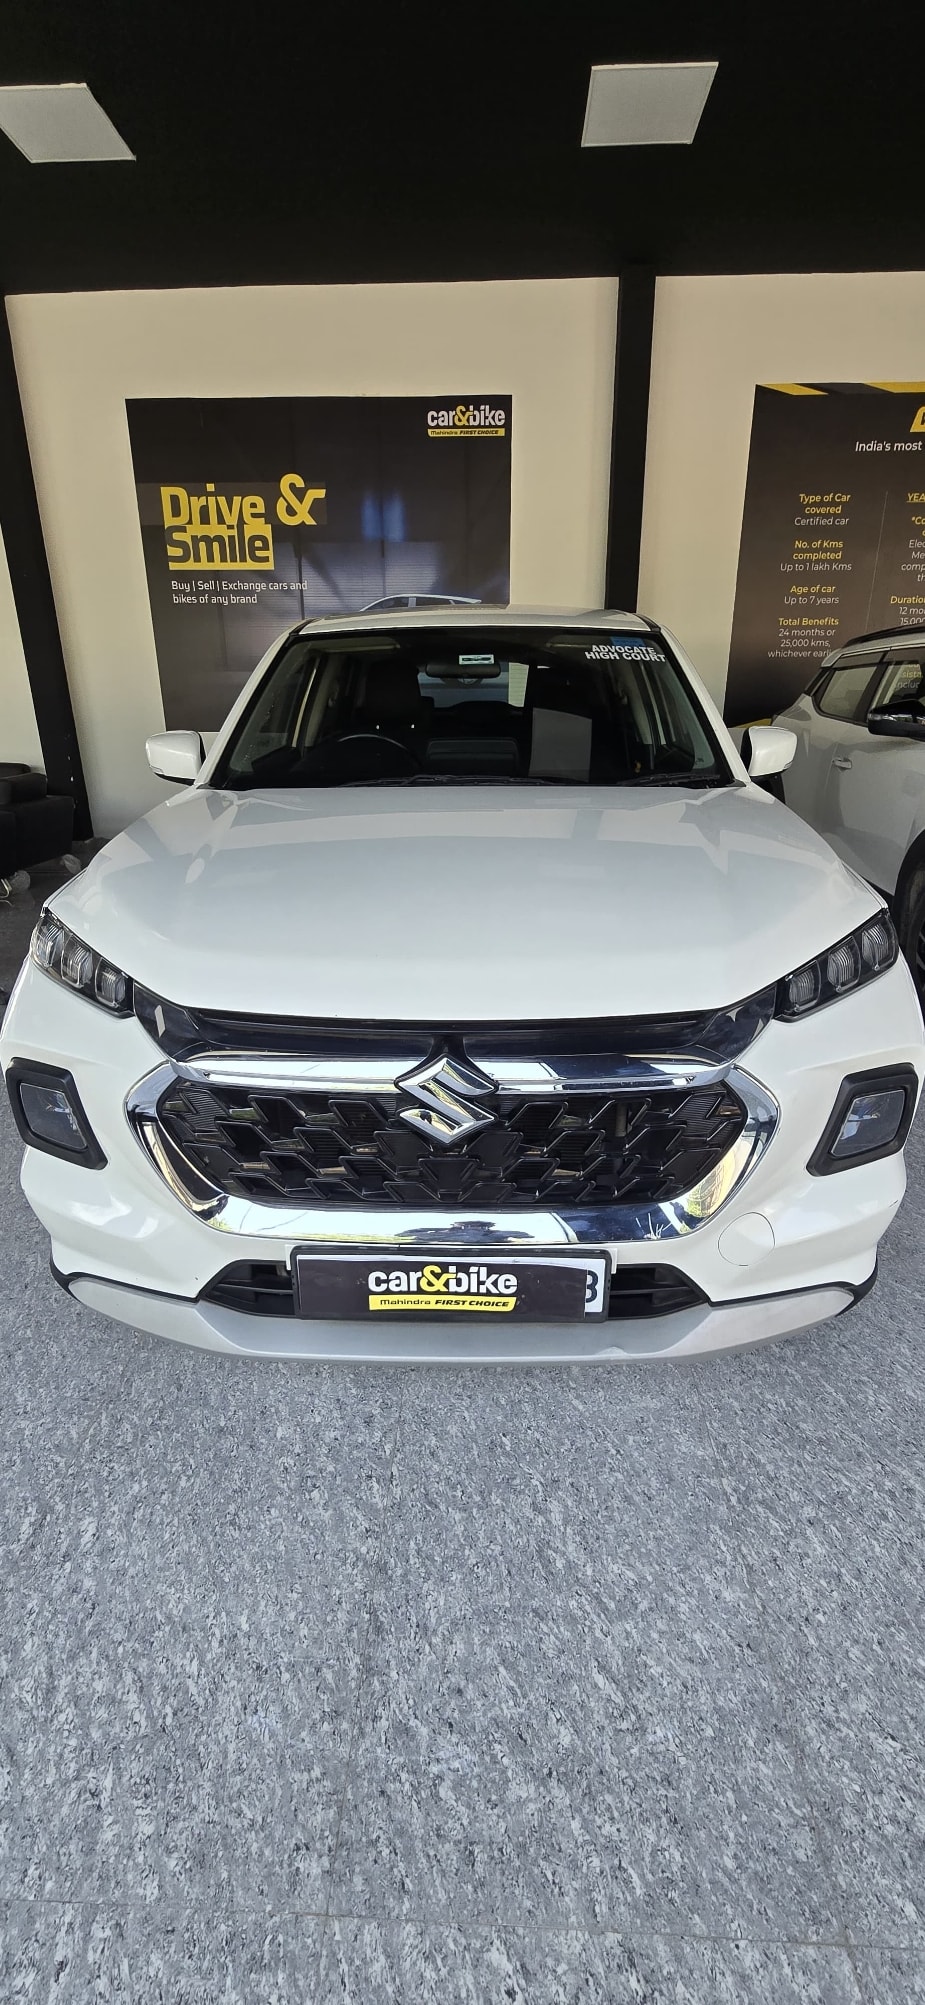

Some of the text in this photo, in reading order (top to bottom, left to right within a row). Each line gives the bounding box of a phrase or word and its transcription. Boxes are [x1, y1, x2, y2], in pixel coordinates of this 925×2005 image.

[427, 404, 506, 427] car&bike
[855, 440, 923, 452] India's most
[160, 473, 327, 526] Drive &
[799, 492, 851, 504] Type of Car
[804, 504, 842, 514] covered
[794, 516, 850, 526] Certified car
[164, 523, 271, 564] Smile
[794, 539, 844, 549] No. of Kms
[792, 551, 842, 561] completed
[780, 562, 794, 573] Up
[795, 563, 804, 571] to
[811, 562, 830, 571] lakh
[831, 563, 852, 571] Kms
[171, 580, 190, 593] Buy
[197, 580, 215, 590] Sell
[222, 580, 267, 593] Exchange
[268, 582, 288, 590] cars
[290, 580, 308, 590] and
[790, 585, 808, 595] Age
[810, 584, 821, 593] of
[173, 594, 258, 605] bikes of any brand
[784, 596, 840, 606] Up to 7 years
[899, 606, 925, 615] 12 mo
[778, 617, 839, 626] Total Benefits
[778, 628, 836, 637] 24 months or
[780, 638, 831, 648] 25,000 kms,
[591, 644, 657, 656] ADVOCATE
[767, 649, 832, 658] whichever earli
[584, 651, 666, 663] HIGH COURT
[367, 1264, 518, 1295] car&bike
[379, 1298, 431, 1306] Mahindra
